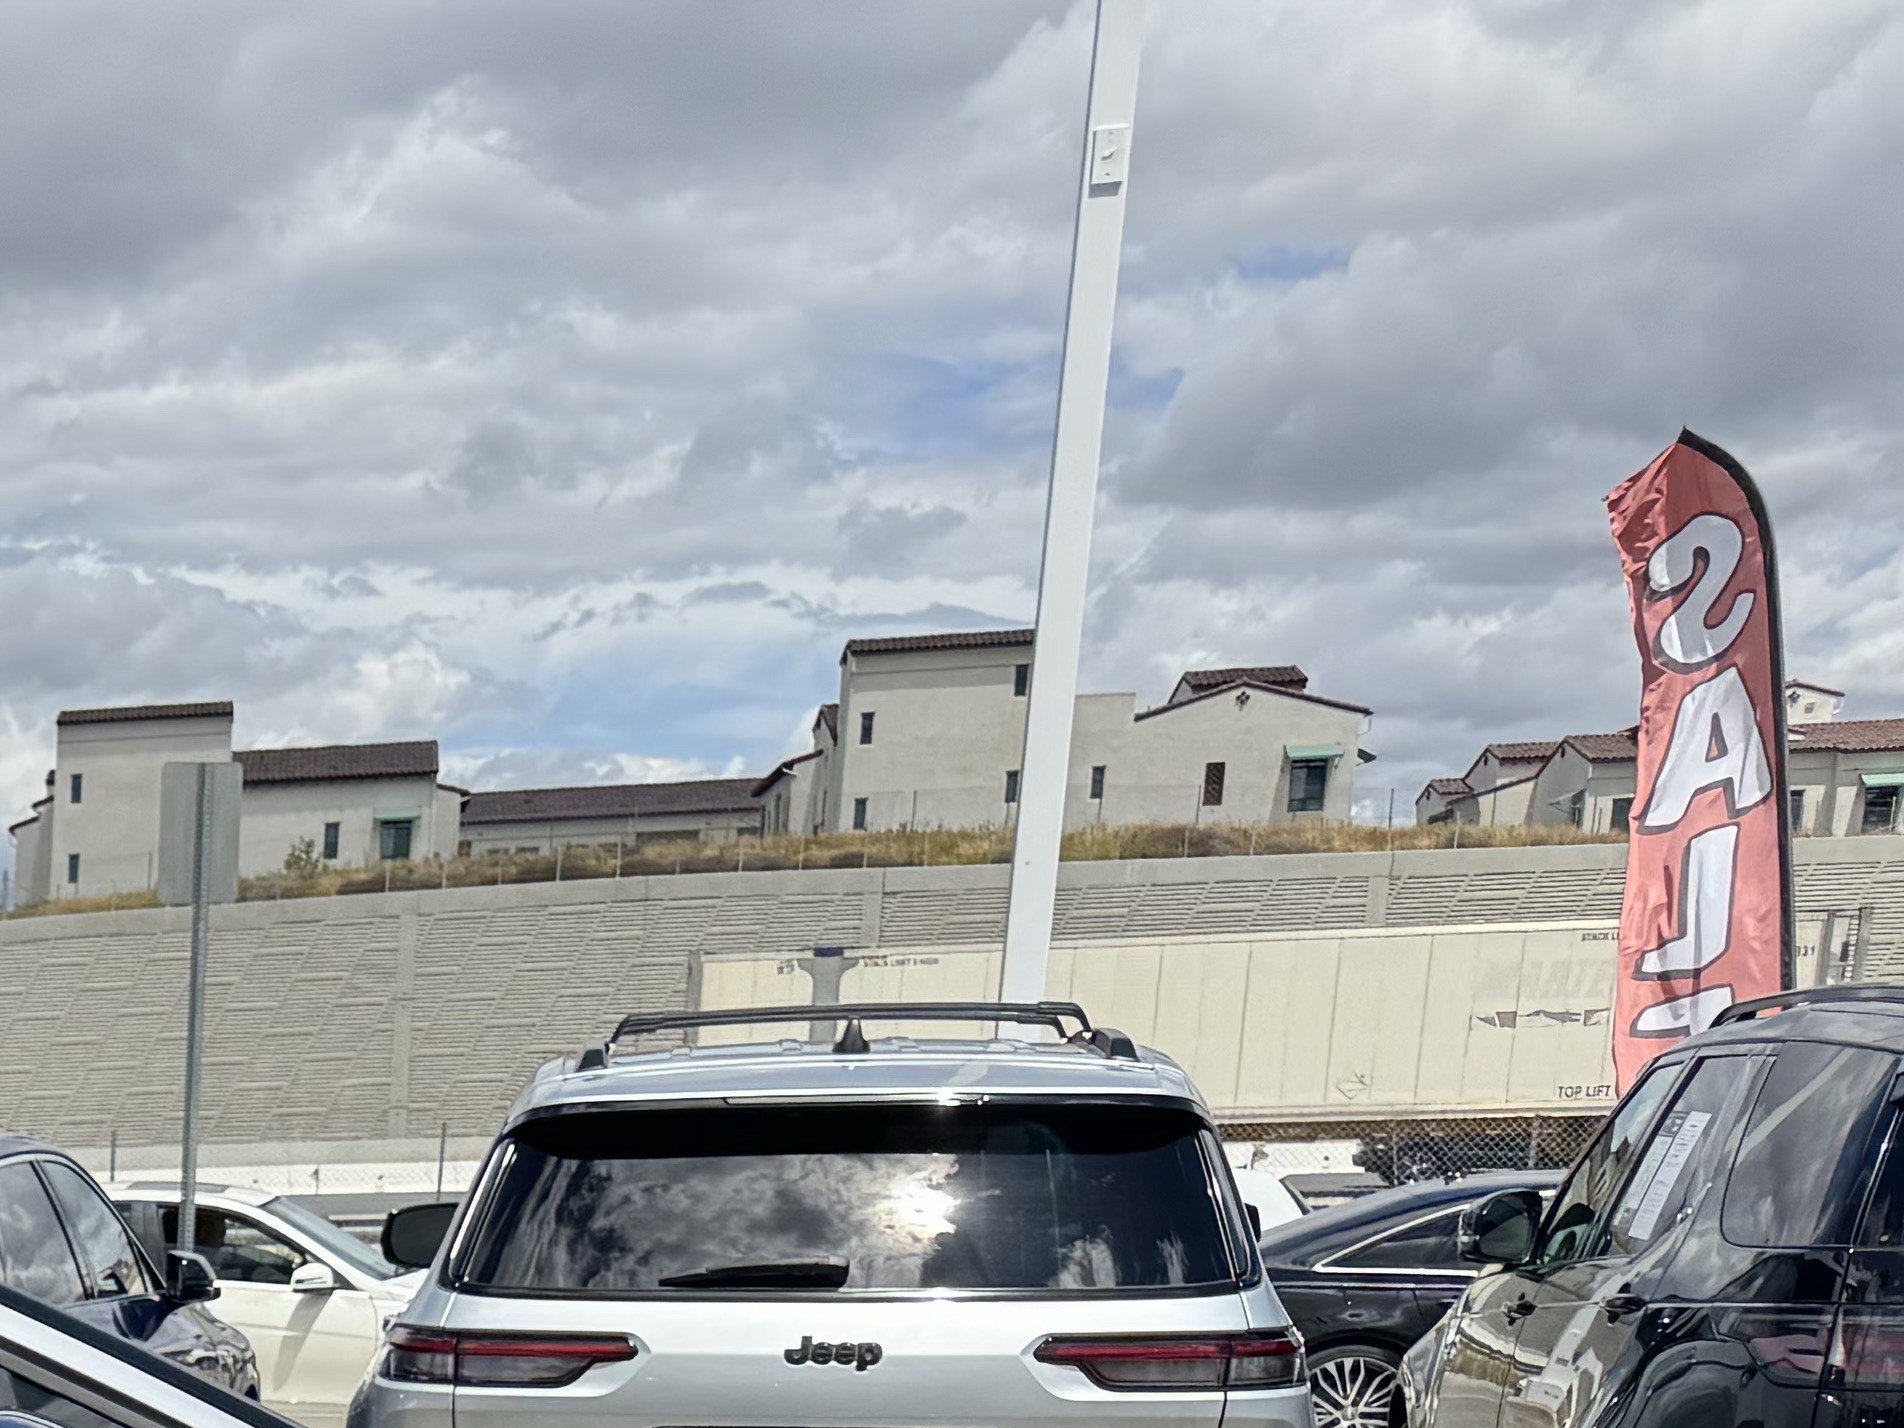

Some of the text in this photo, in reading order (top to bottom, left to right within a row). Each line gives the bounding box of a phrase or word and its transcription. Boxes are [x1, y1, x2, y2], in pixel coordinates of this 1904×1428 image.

[1557, 1084, 1612, 1099] TOP LIFT
[784, 1335, 883, 1372] Jeep
